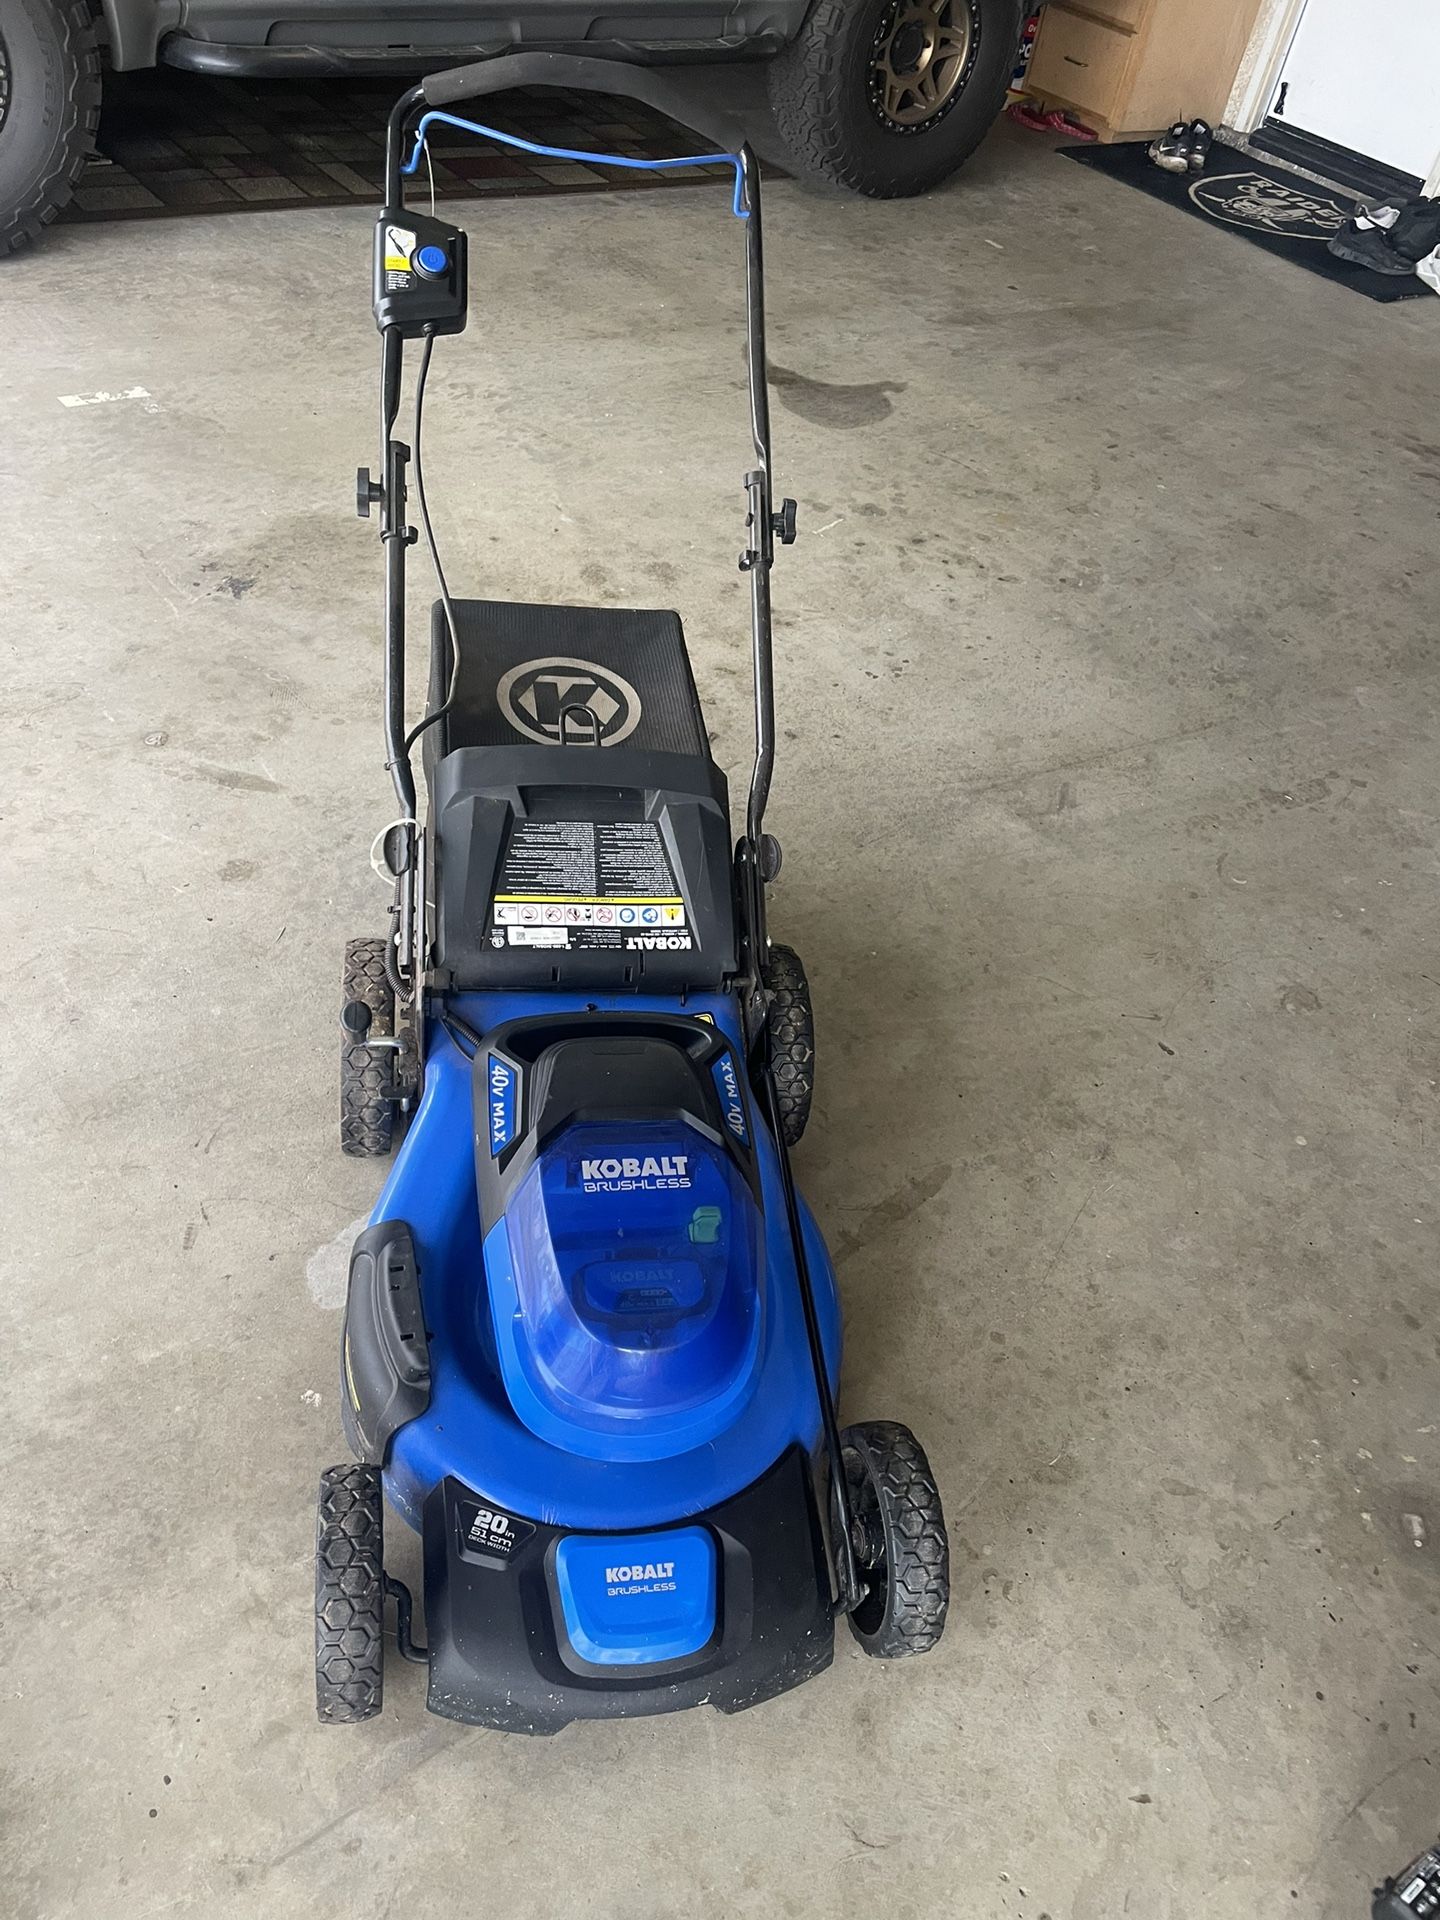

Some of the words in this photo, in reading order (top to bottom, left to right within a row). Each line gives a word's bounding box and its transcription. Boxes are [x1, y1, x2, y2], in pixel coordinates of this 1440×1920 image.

[1250, 180, 1346, 220] RAIDE
[626, 936, 692, 950] KOBALT
[721, 1061, 738, 1098] MAX
[493, 1102, 506, 1142] MAX
[582, 1156, 688, 1179] KOBALT
[584, 1178, 692, 1192] BRUSHLESS
[468, 1534, 487, 1545] DECK
[487, 1541, 511, 1552] WIDTH
[471, 1526, 487, 1539] 51
[490, 1535, 512, 1547] cm
[606, 1562, 675, 1583] KOBALT
[607, 1582, 677, 1596] BRUSHLESS
